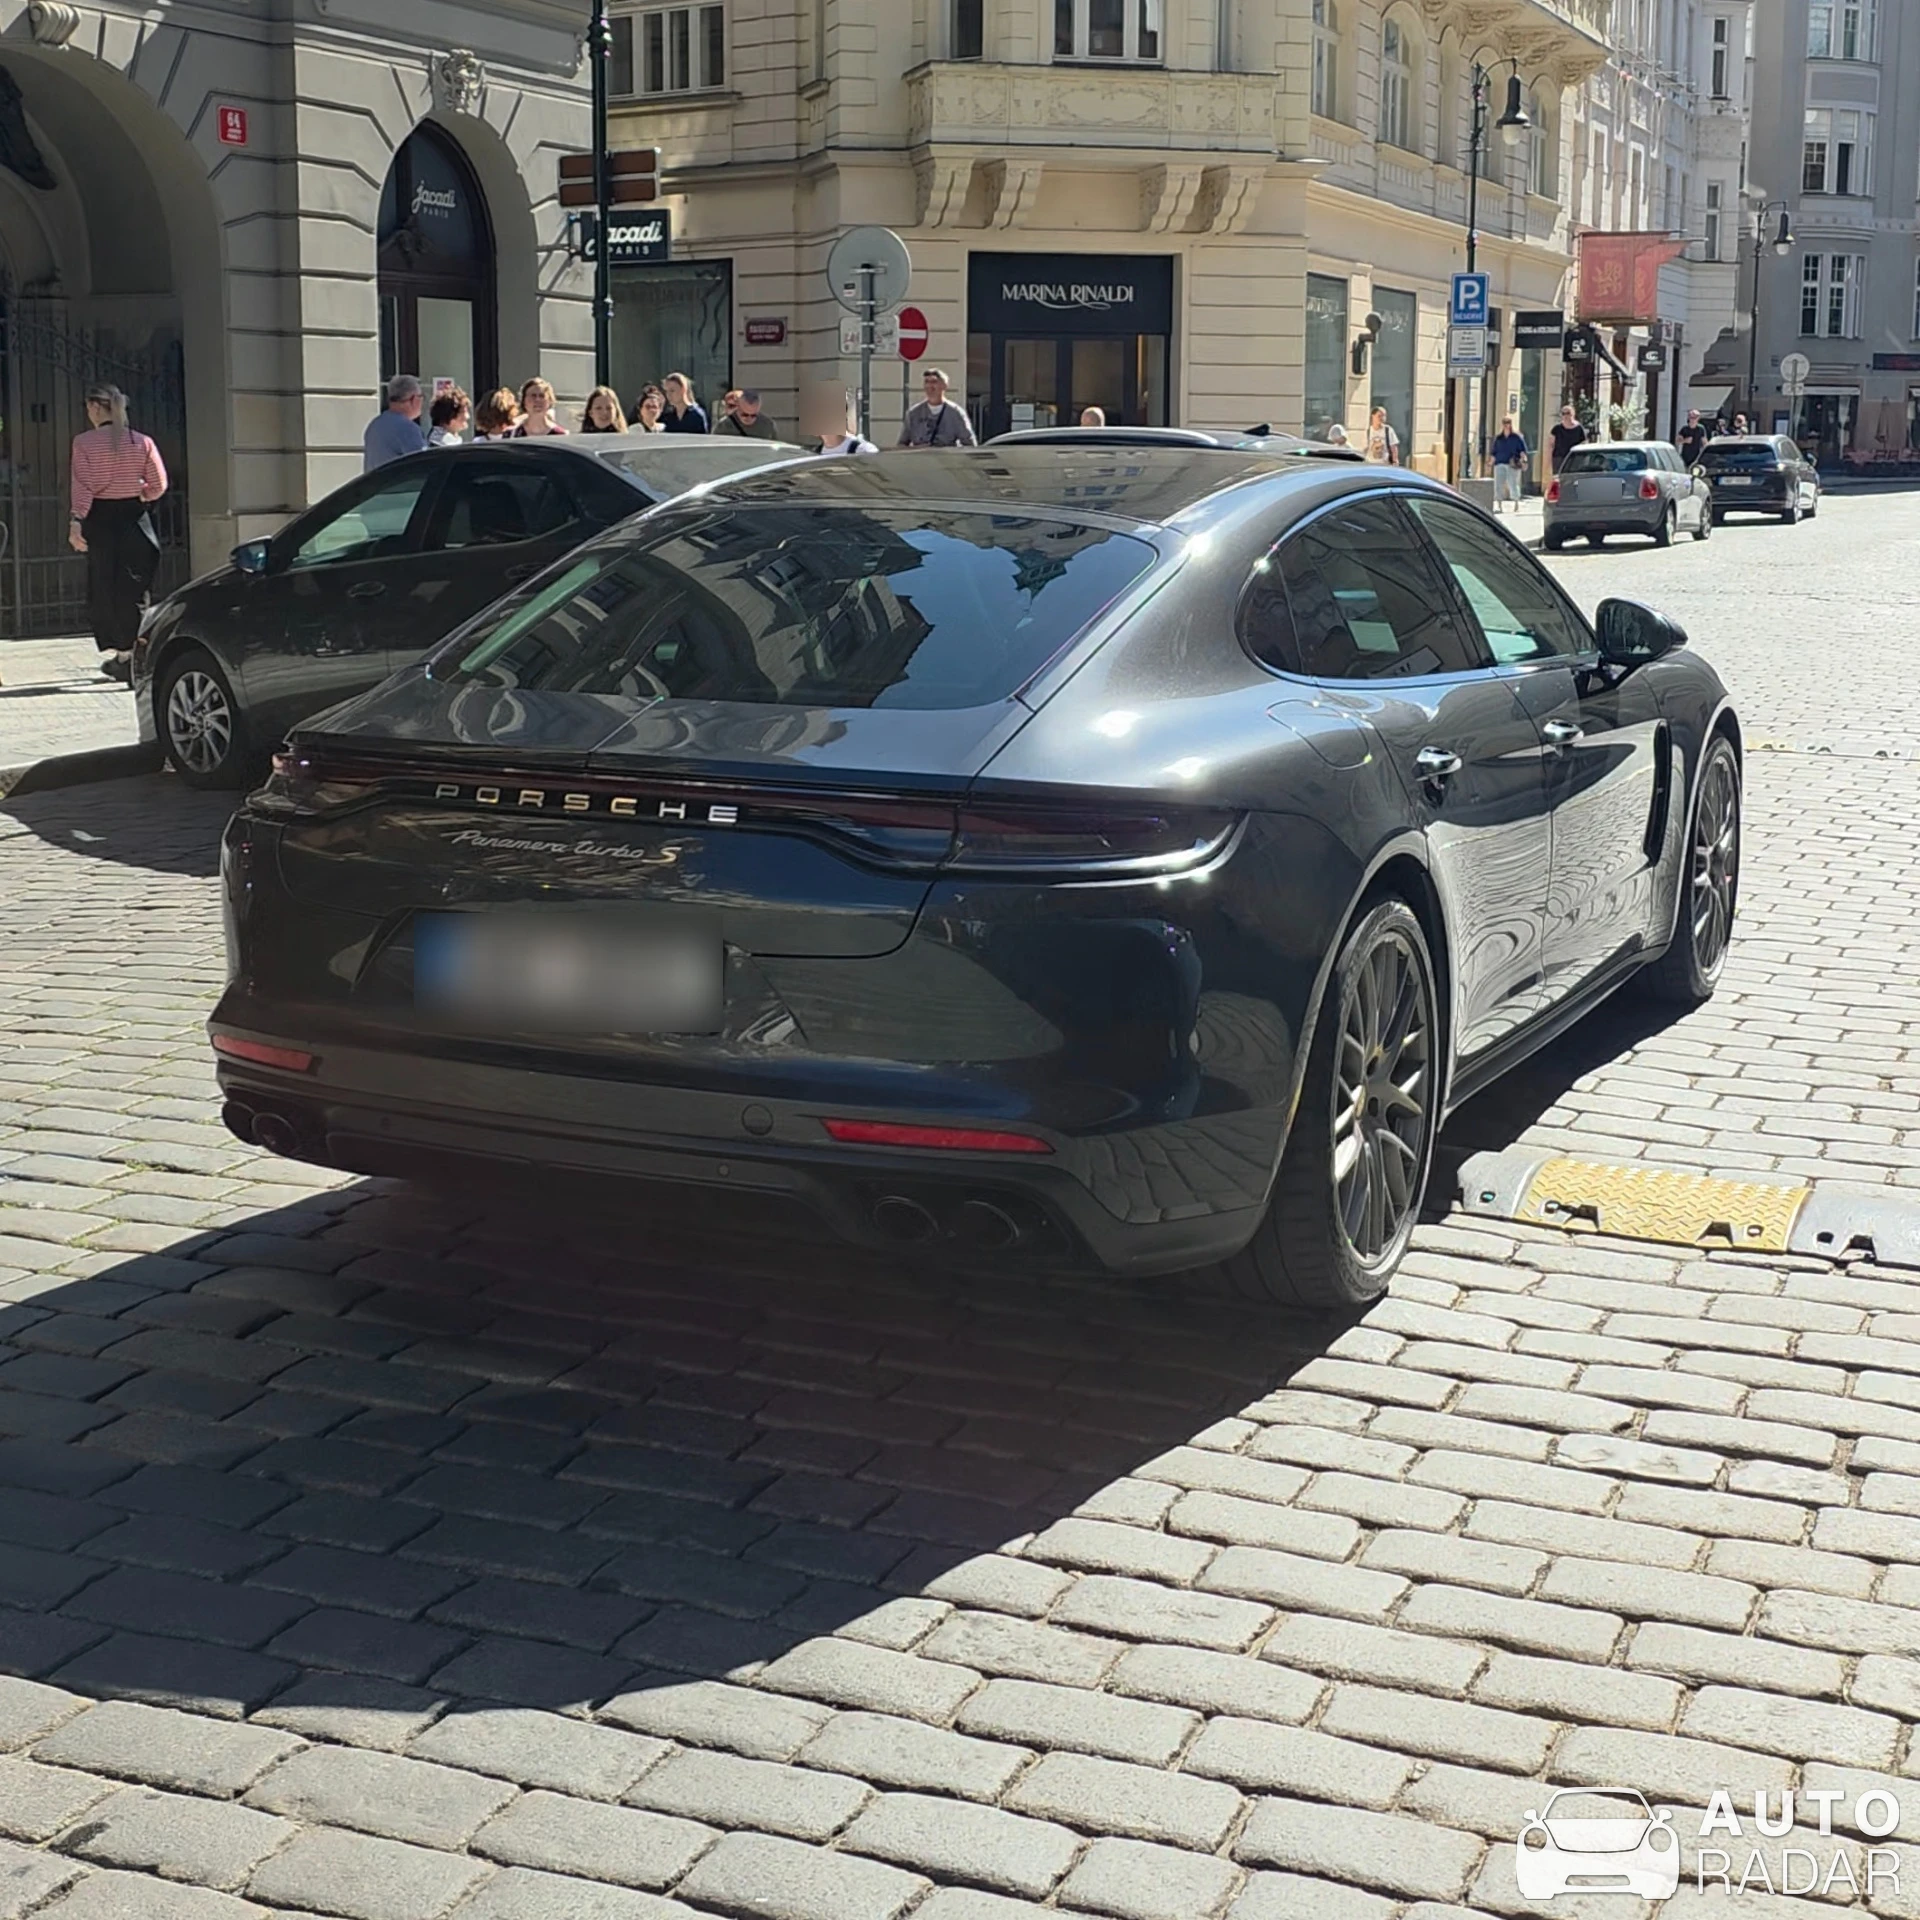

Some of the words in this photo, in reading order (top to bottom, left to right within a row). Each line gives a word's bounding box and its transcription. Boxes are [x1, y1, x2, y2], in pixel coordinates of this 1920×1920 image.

[411, 179, 456, 214] jacadi
[1002, 283, 1067, 306] MARINA
[1070, 284, 1134, 308] RINALDI
[1459, 280, 1480, 310] P
[435, 784, 739, 823] PORSCHE
[446, 829, 566, 853] Panamera
[573, 840, 644, 859] turbo
[641, 846, 683, 864] S
